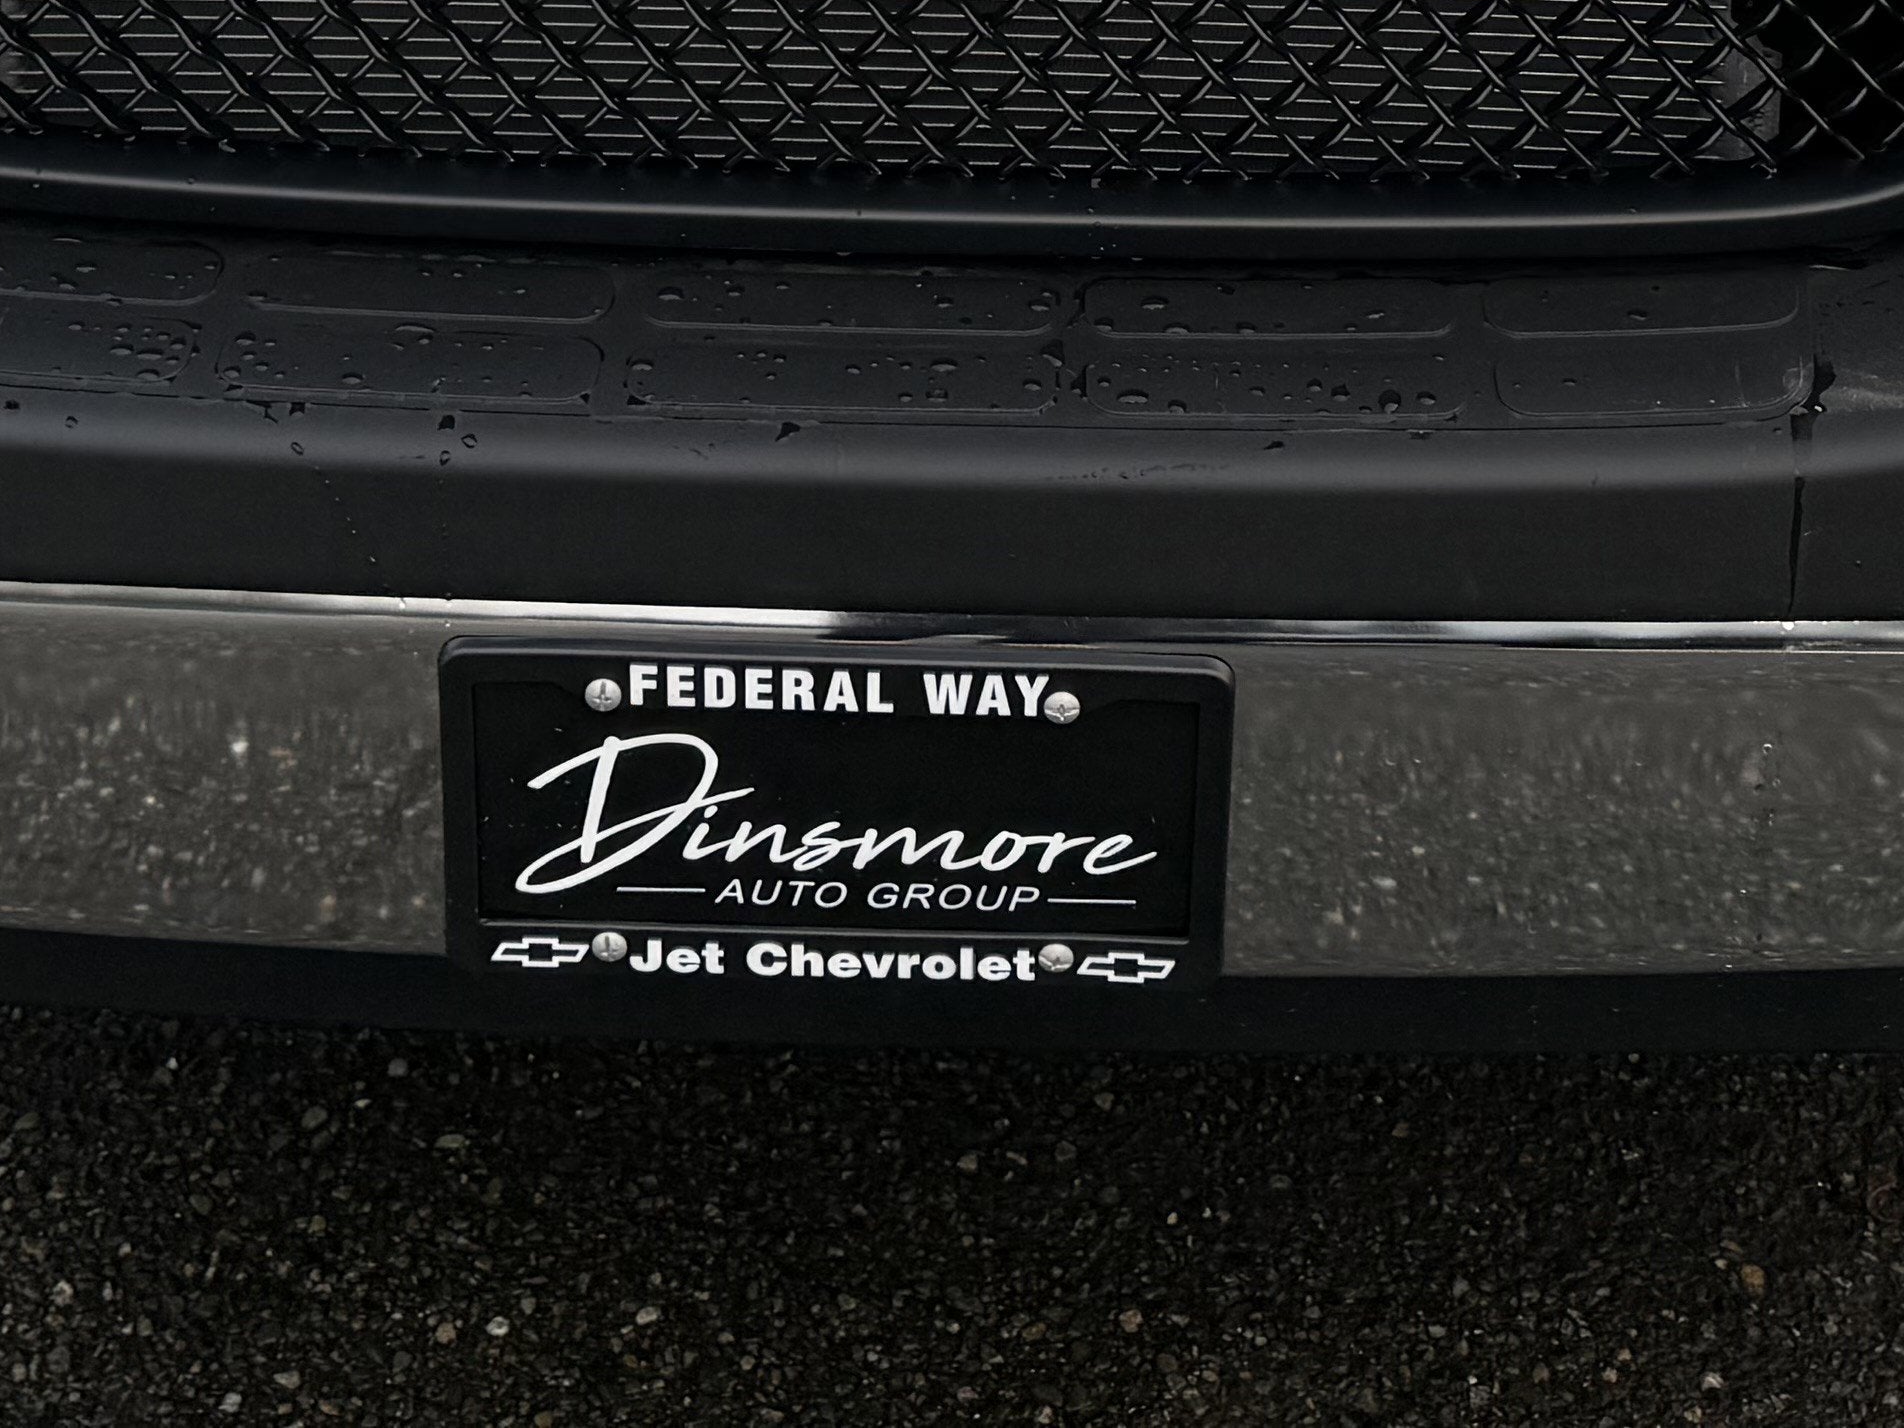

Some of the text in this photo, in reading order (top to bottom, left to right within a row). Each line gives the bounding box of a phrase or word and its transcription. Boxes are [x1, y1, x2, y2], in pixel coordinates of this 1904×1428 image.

[630, 663, 1050, 717] FEDERAL WAY
[515, 733, 1158, 894] Dinsmore
[715, 878, 1040, 912] AUTO GROUP
[629, 939, 1036, 982] Jet Chevrolet
